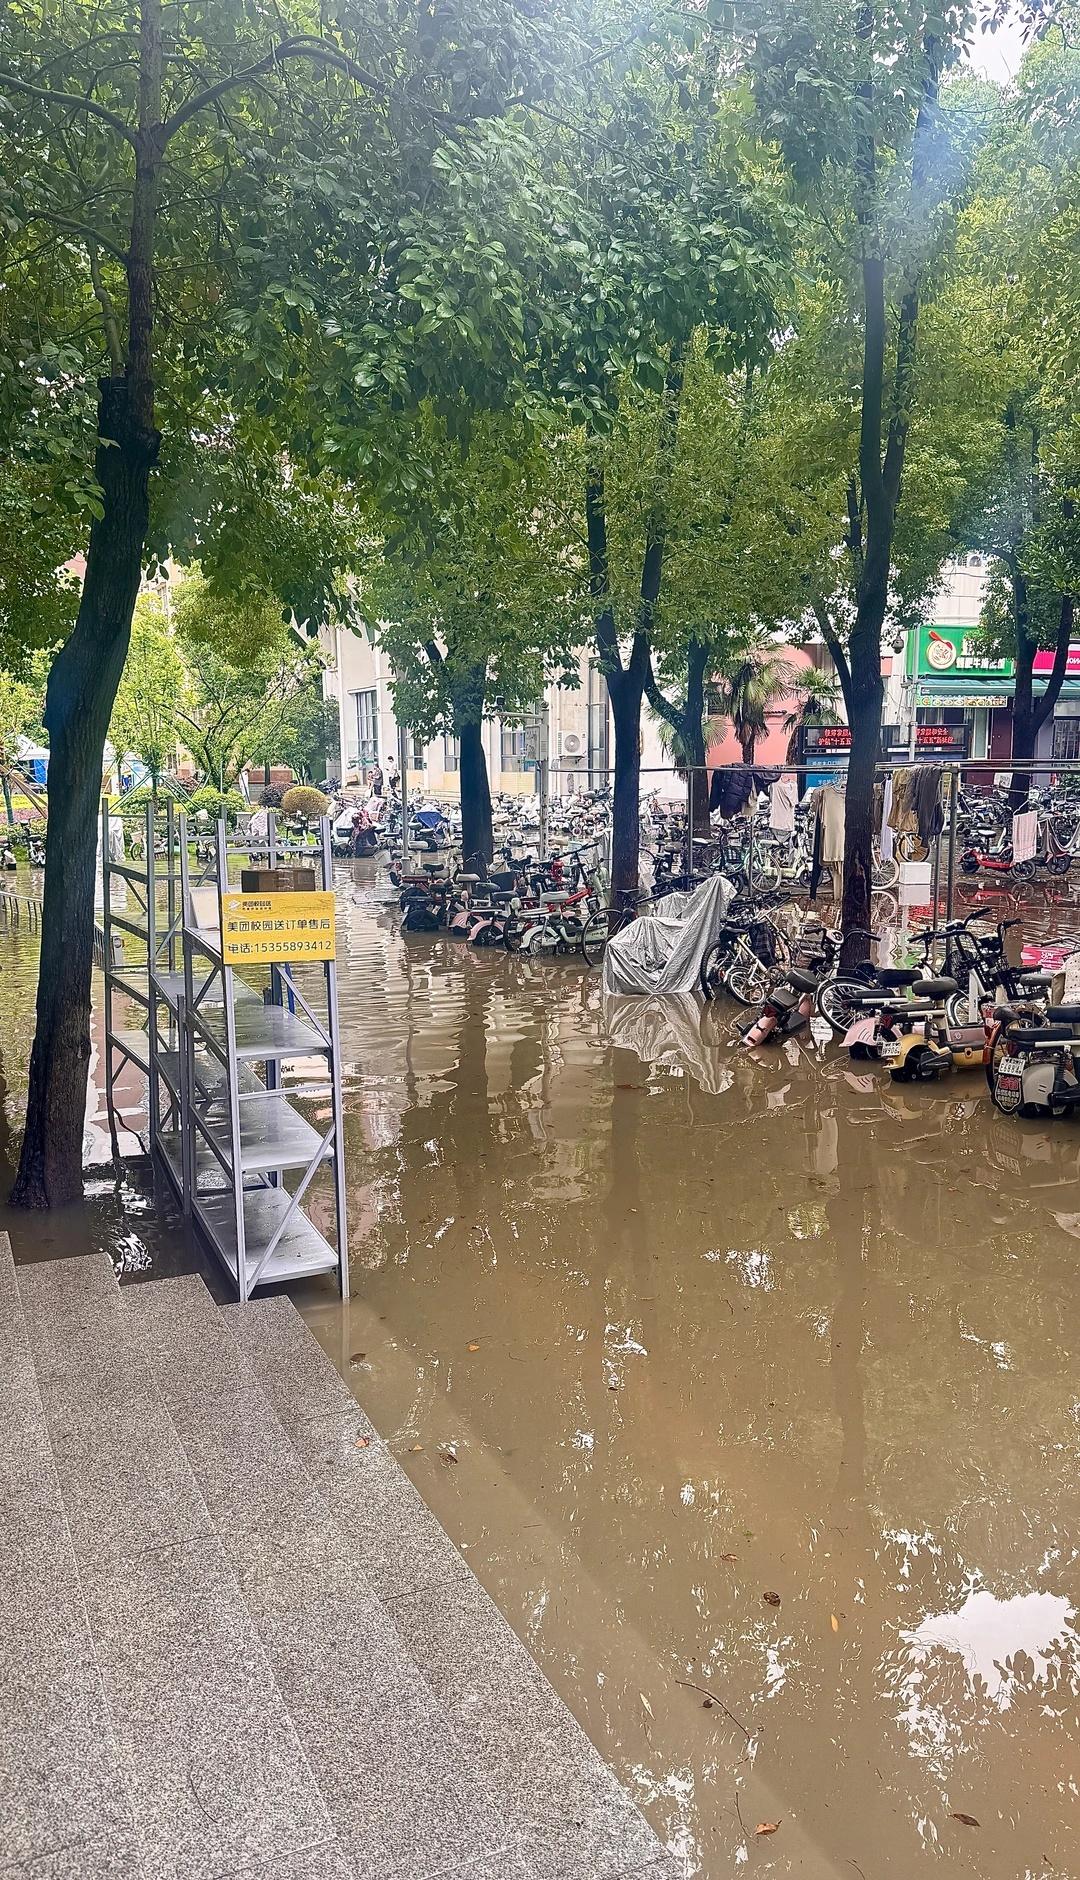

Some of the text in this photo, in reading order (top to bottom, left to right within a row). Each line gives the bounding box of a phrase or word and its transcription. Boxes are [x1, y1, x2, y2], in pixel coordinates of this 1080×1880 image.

[227, 918, 330, 933] 美团校园送订单售后
